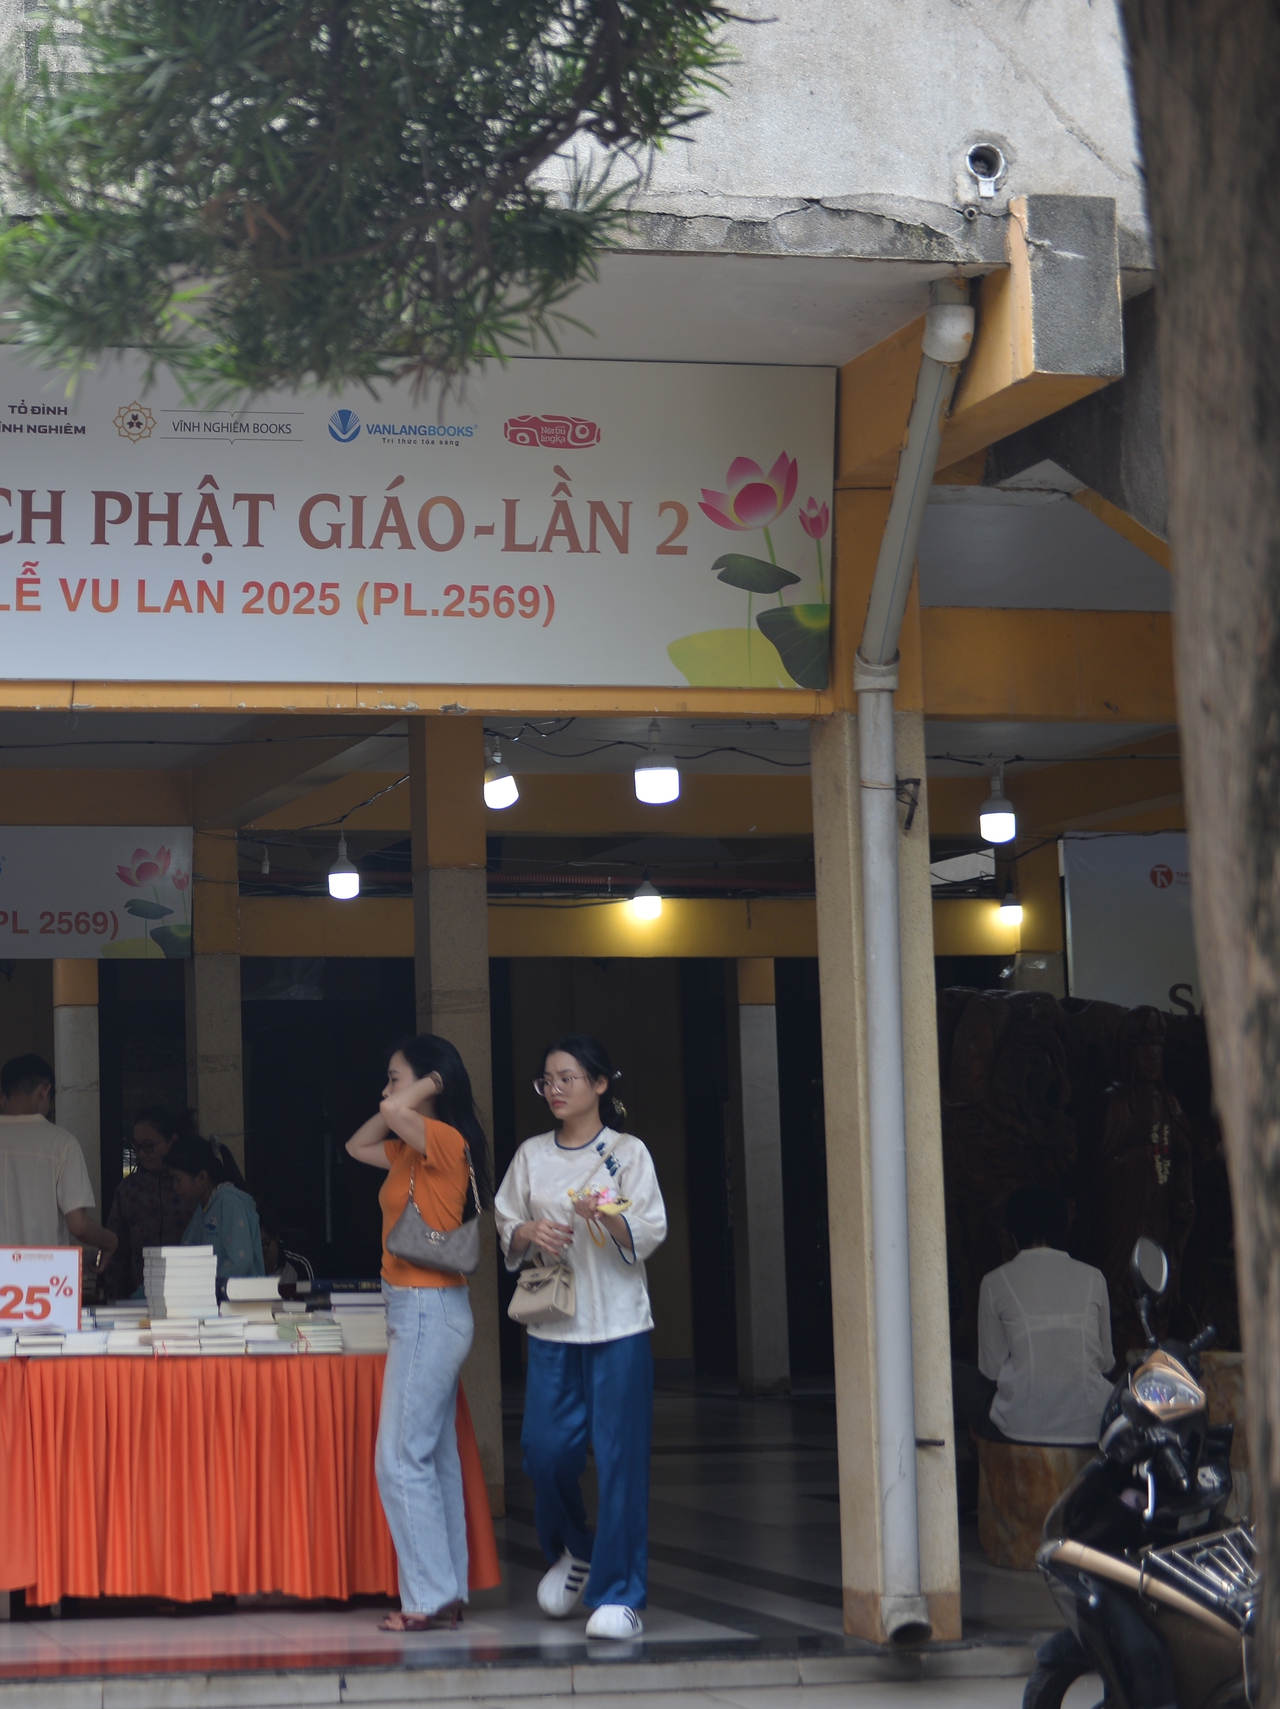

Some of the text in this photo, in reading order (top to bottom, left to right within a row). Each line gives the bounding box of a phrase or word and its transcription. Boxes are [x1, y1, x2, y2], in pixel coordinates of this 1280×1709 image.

[8, 400, 68, 416] TỔ ĐÌNH
[26, 422, 86, 435] NGHIÊM
[172, 420, 292, 435] VĨNH NGHIÊM BOOKS
[366, 424, 474, 438] VANLANGBOOKS
[540, 426, 566, 434] Norbu
[540, 435, 566, 444] lingka
[90, 474, 275, 565] PHẬT
[656, 501, 690, 556] 2
[59, 577, 120, 614] VU
[136, 579, 225, 615] LAN
[242, 581, 341, 616] 2025
[356, 581, 556, 627] (PL.2569)
[39, 910, 119, 941] 2569)
